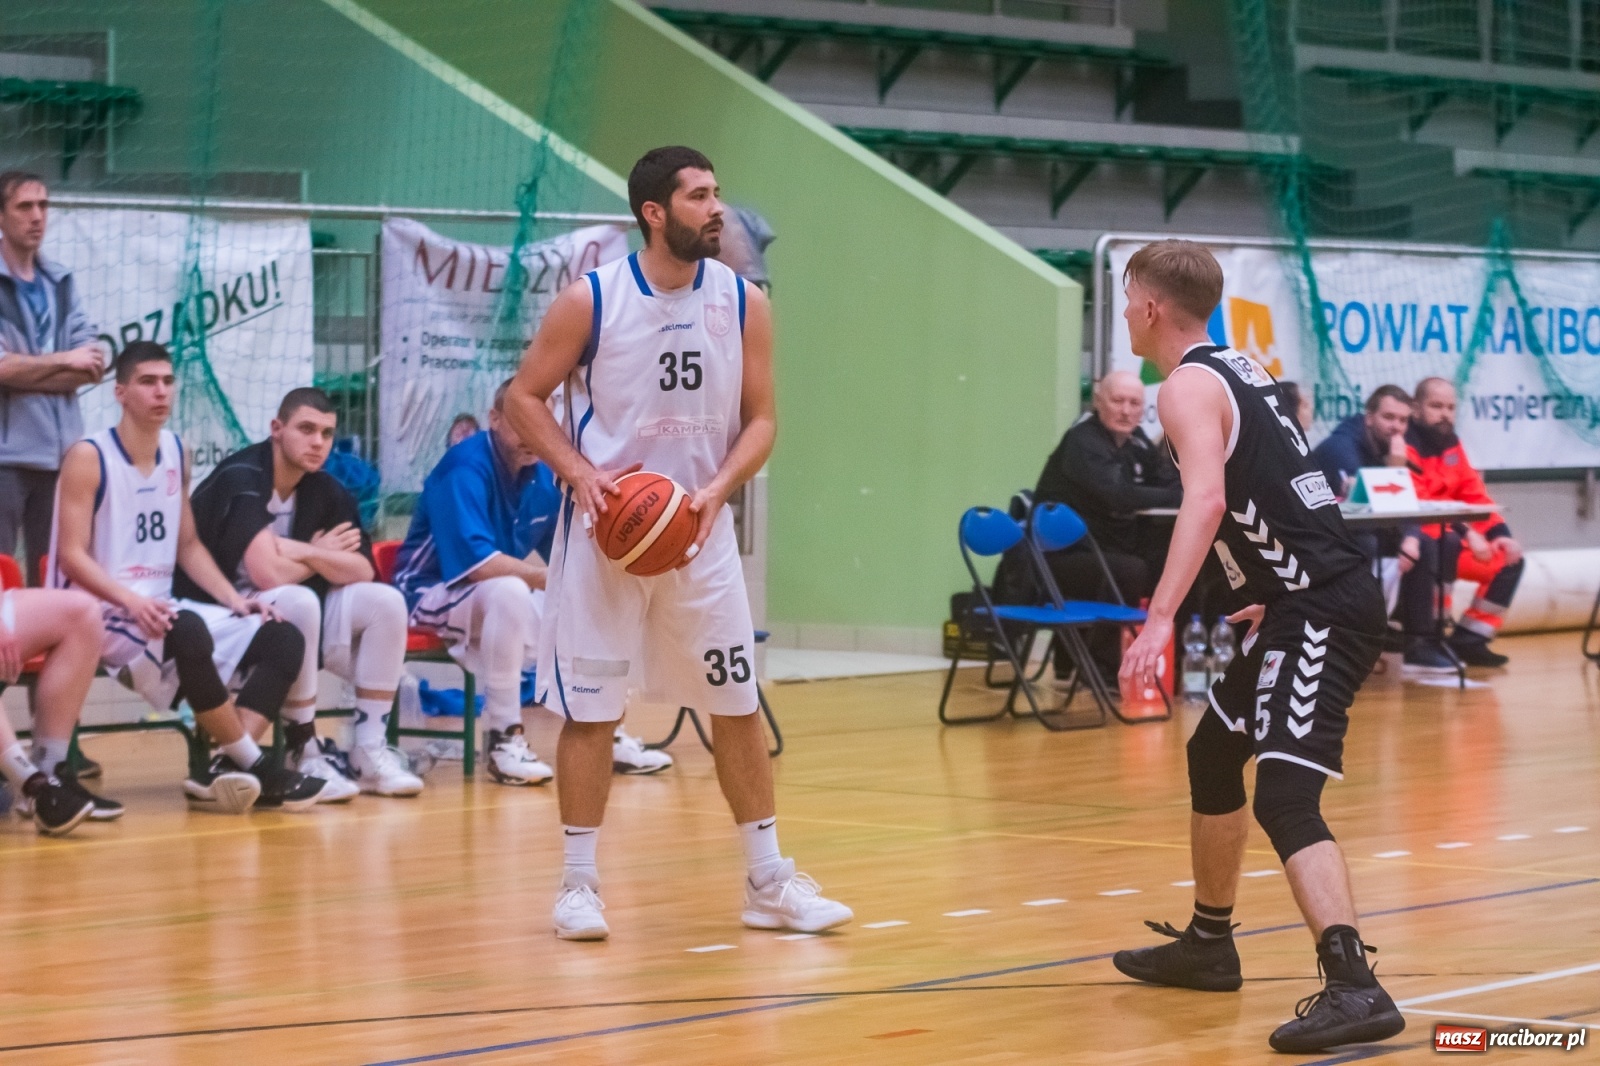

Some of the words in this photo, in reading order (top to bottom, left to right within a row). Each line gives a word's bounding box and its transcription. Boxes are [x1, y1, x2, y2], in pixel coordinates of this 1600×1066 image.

[1320, 301, 1469, 353] POWIAT
[659, 351, 703, 391] 35
[1264, 395, 1308, 457] 5
[136, 511, 166, 543] 88
[616, 491, 660, 542] molten
[703, 645, 751, 686] 35
[1254, 693, 1272, 741] 5
